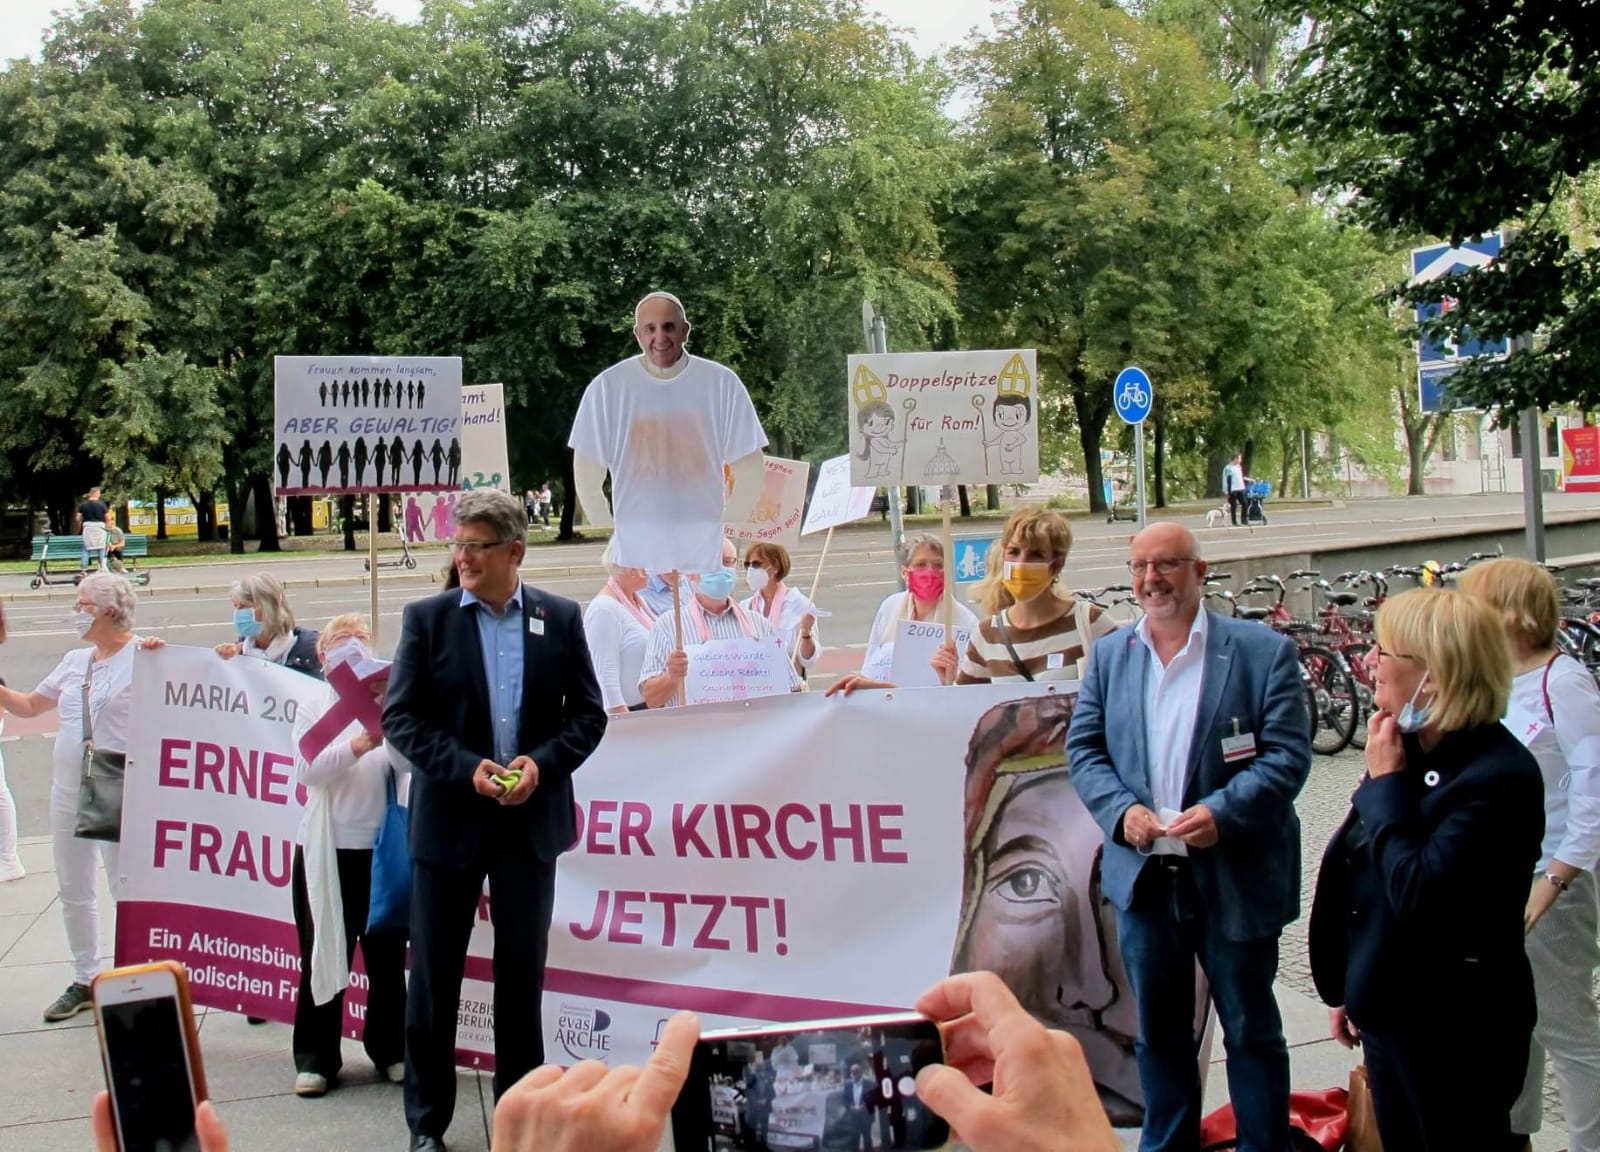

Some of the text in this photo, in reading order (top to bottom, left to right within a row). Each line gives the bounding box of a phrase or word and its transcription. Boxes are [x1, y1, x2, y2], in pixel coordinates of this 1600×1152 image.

[350, 364, 391, 375] kommen
[396, 364, 437, 376] langsam,
[886, 370, 997, 392] Doppelspitze
[284, 417, 458, 434] ABER GEWALTIG!
[462, 408, 501, 425] hand!
[910, 414, 981, 431] für Rom!
[756, 525, 782, 539] Segen
[908, 624, 945, 639] 2000
[165, 680, 297, 724] MARIA 2.0
[672, 803, 908, 863] KIRCHE
[153, 820, 292, 888] FRAU
[569, 890, 789, 956] JETZT!
[149, 928, 182, 950] Ein
[183, 961, 273, 997] holischen
[457, 1013, 494, 1030] BERLIN
[559, 1016, 591, 1031] evas
[554, 1027, 611, 1051] ARCHE
